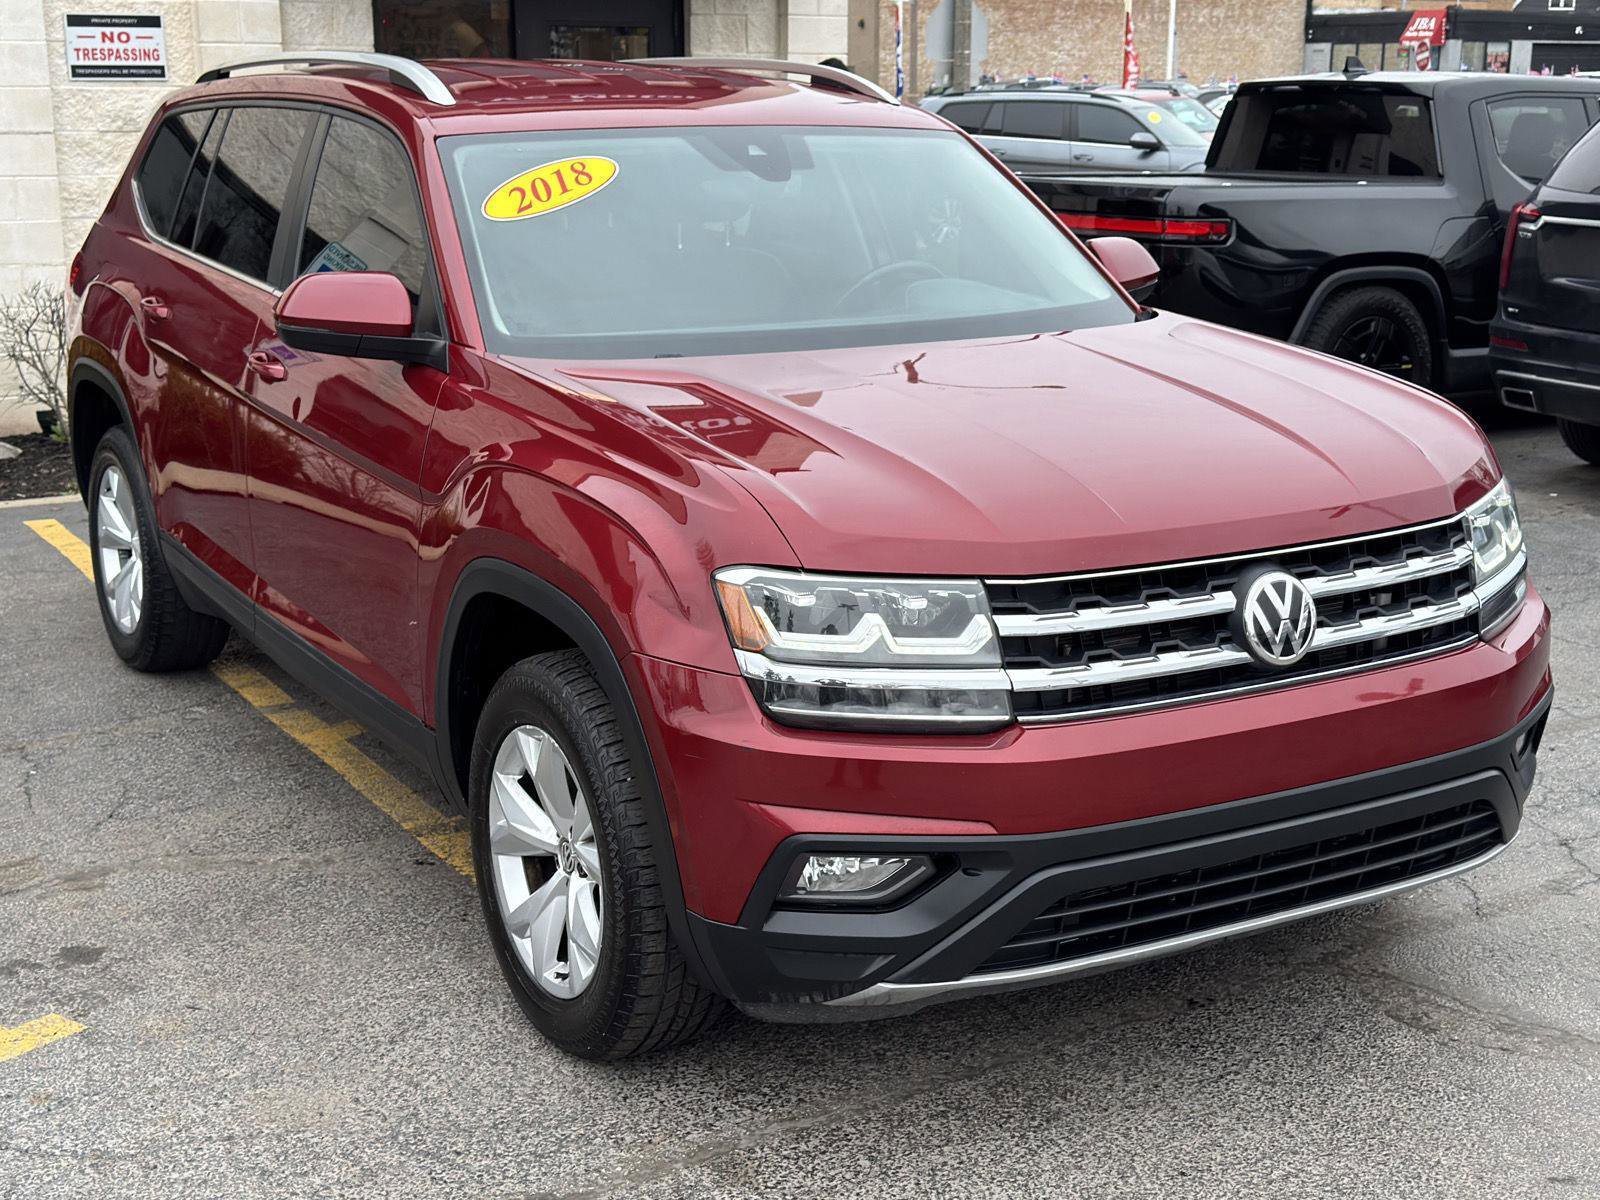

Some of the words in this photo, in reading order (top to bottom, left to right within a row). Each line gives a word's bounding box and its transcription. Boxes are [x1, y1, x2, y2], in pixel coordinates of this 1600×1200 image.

[1408, 16, 1437, 32] JBA
[101, 31, 131, 44] NO
[74, 48, 160, 61] TRESPASSING
[508, 161, 593, 214] 2018
[1244, 572, 1316, 664] VW
